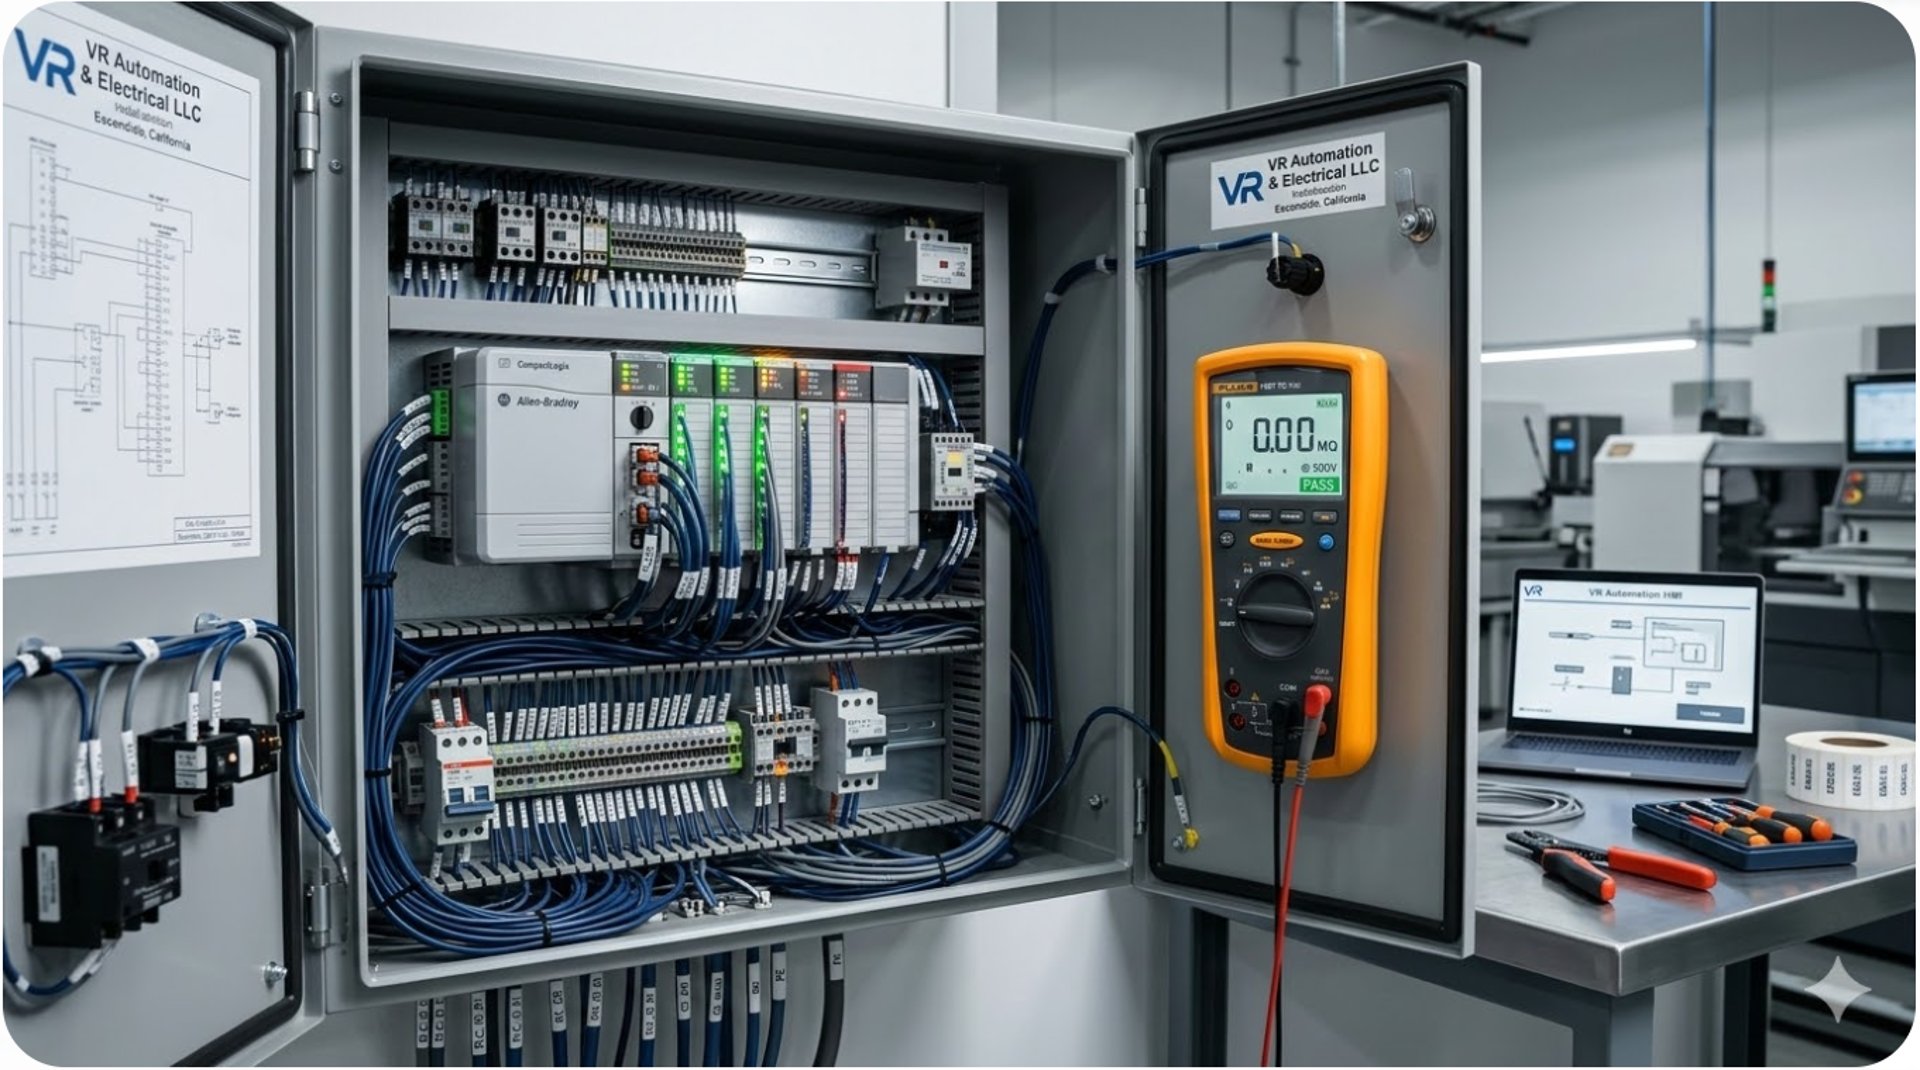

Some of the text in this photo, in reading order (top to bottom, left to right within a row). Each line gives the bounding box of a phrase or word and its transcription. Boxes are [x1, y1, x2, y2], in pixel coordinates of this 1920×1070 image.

[14, 27, 76, 96] VR
[86, 39, 201, 99] VR Automation
[80, 64, 92, 85] &
[98, 70, 169, 112] Electrical
[174, 98, 202, 123] LLC
[1268, 143, 1373, 171] VR Automation
[1268, 158, 1380, 190] & Electrical LLC
[1218, 170, 1264, 206] VR
[1253, 417, 1315, 453] 0.00
[1303, 479, 1334, 491] PASS
[1313, 463, 1338, 473] 500V
[1524, 585, 1543, 597] VR
[1588, 588, 1602, 597] VR
